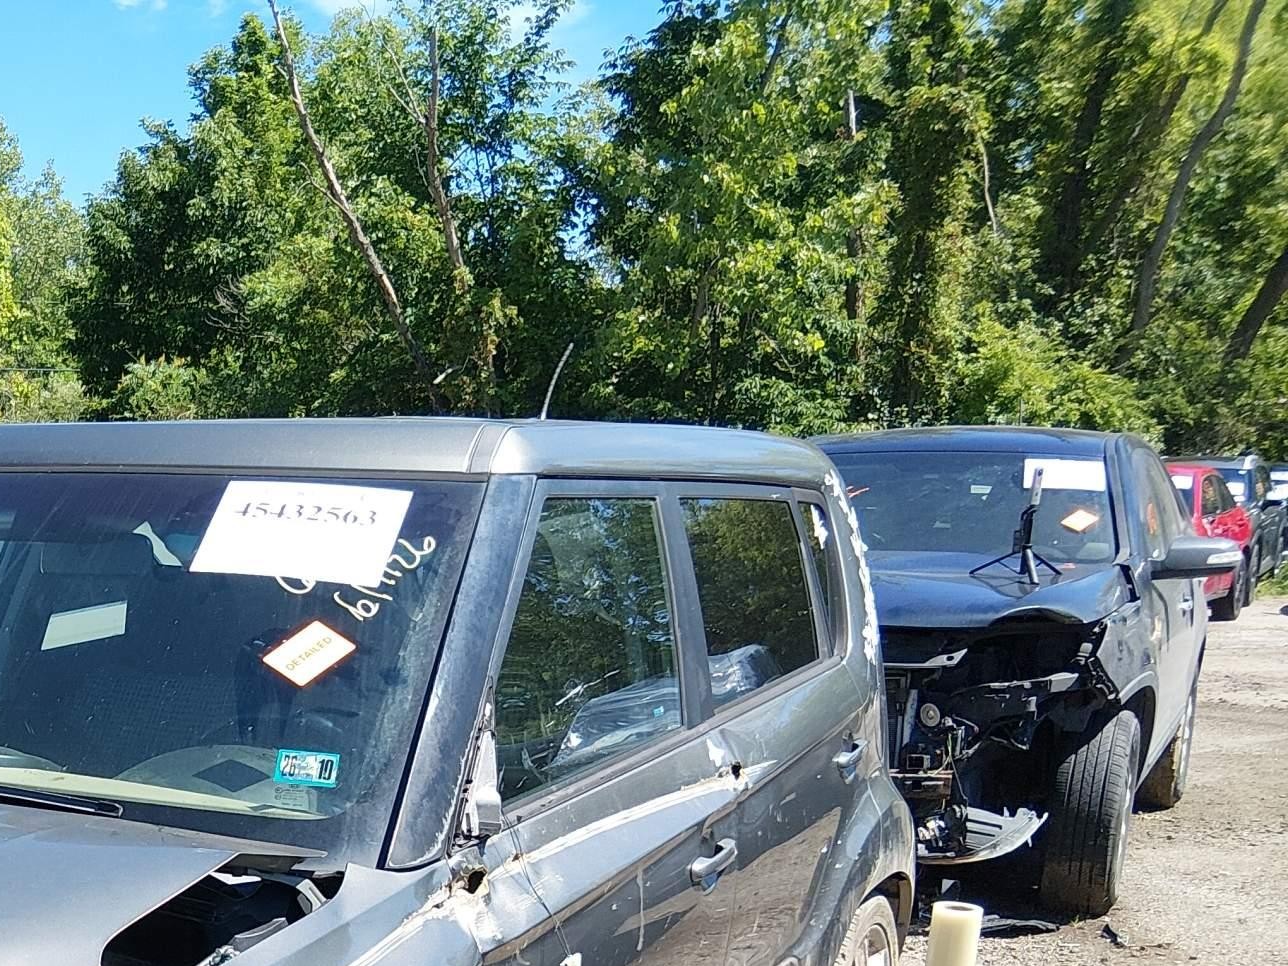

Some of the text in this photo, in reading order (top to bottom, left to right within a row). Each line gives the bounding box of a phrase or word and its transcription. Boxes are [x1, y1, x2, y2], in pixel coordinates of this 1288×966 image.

[235, 501, 378, 526] 45432563
[285, 636, 333, 671] DETAILED
[281, 754, 298, 777] 26
